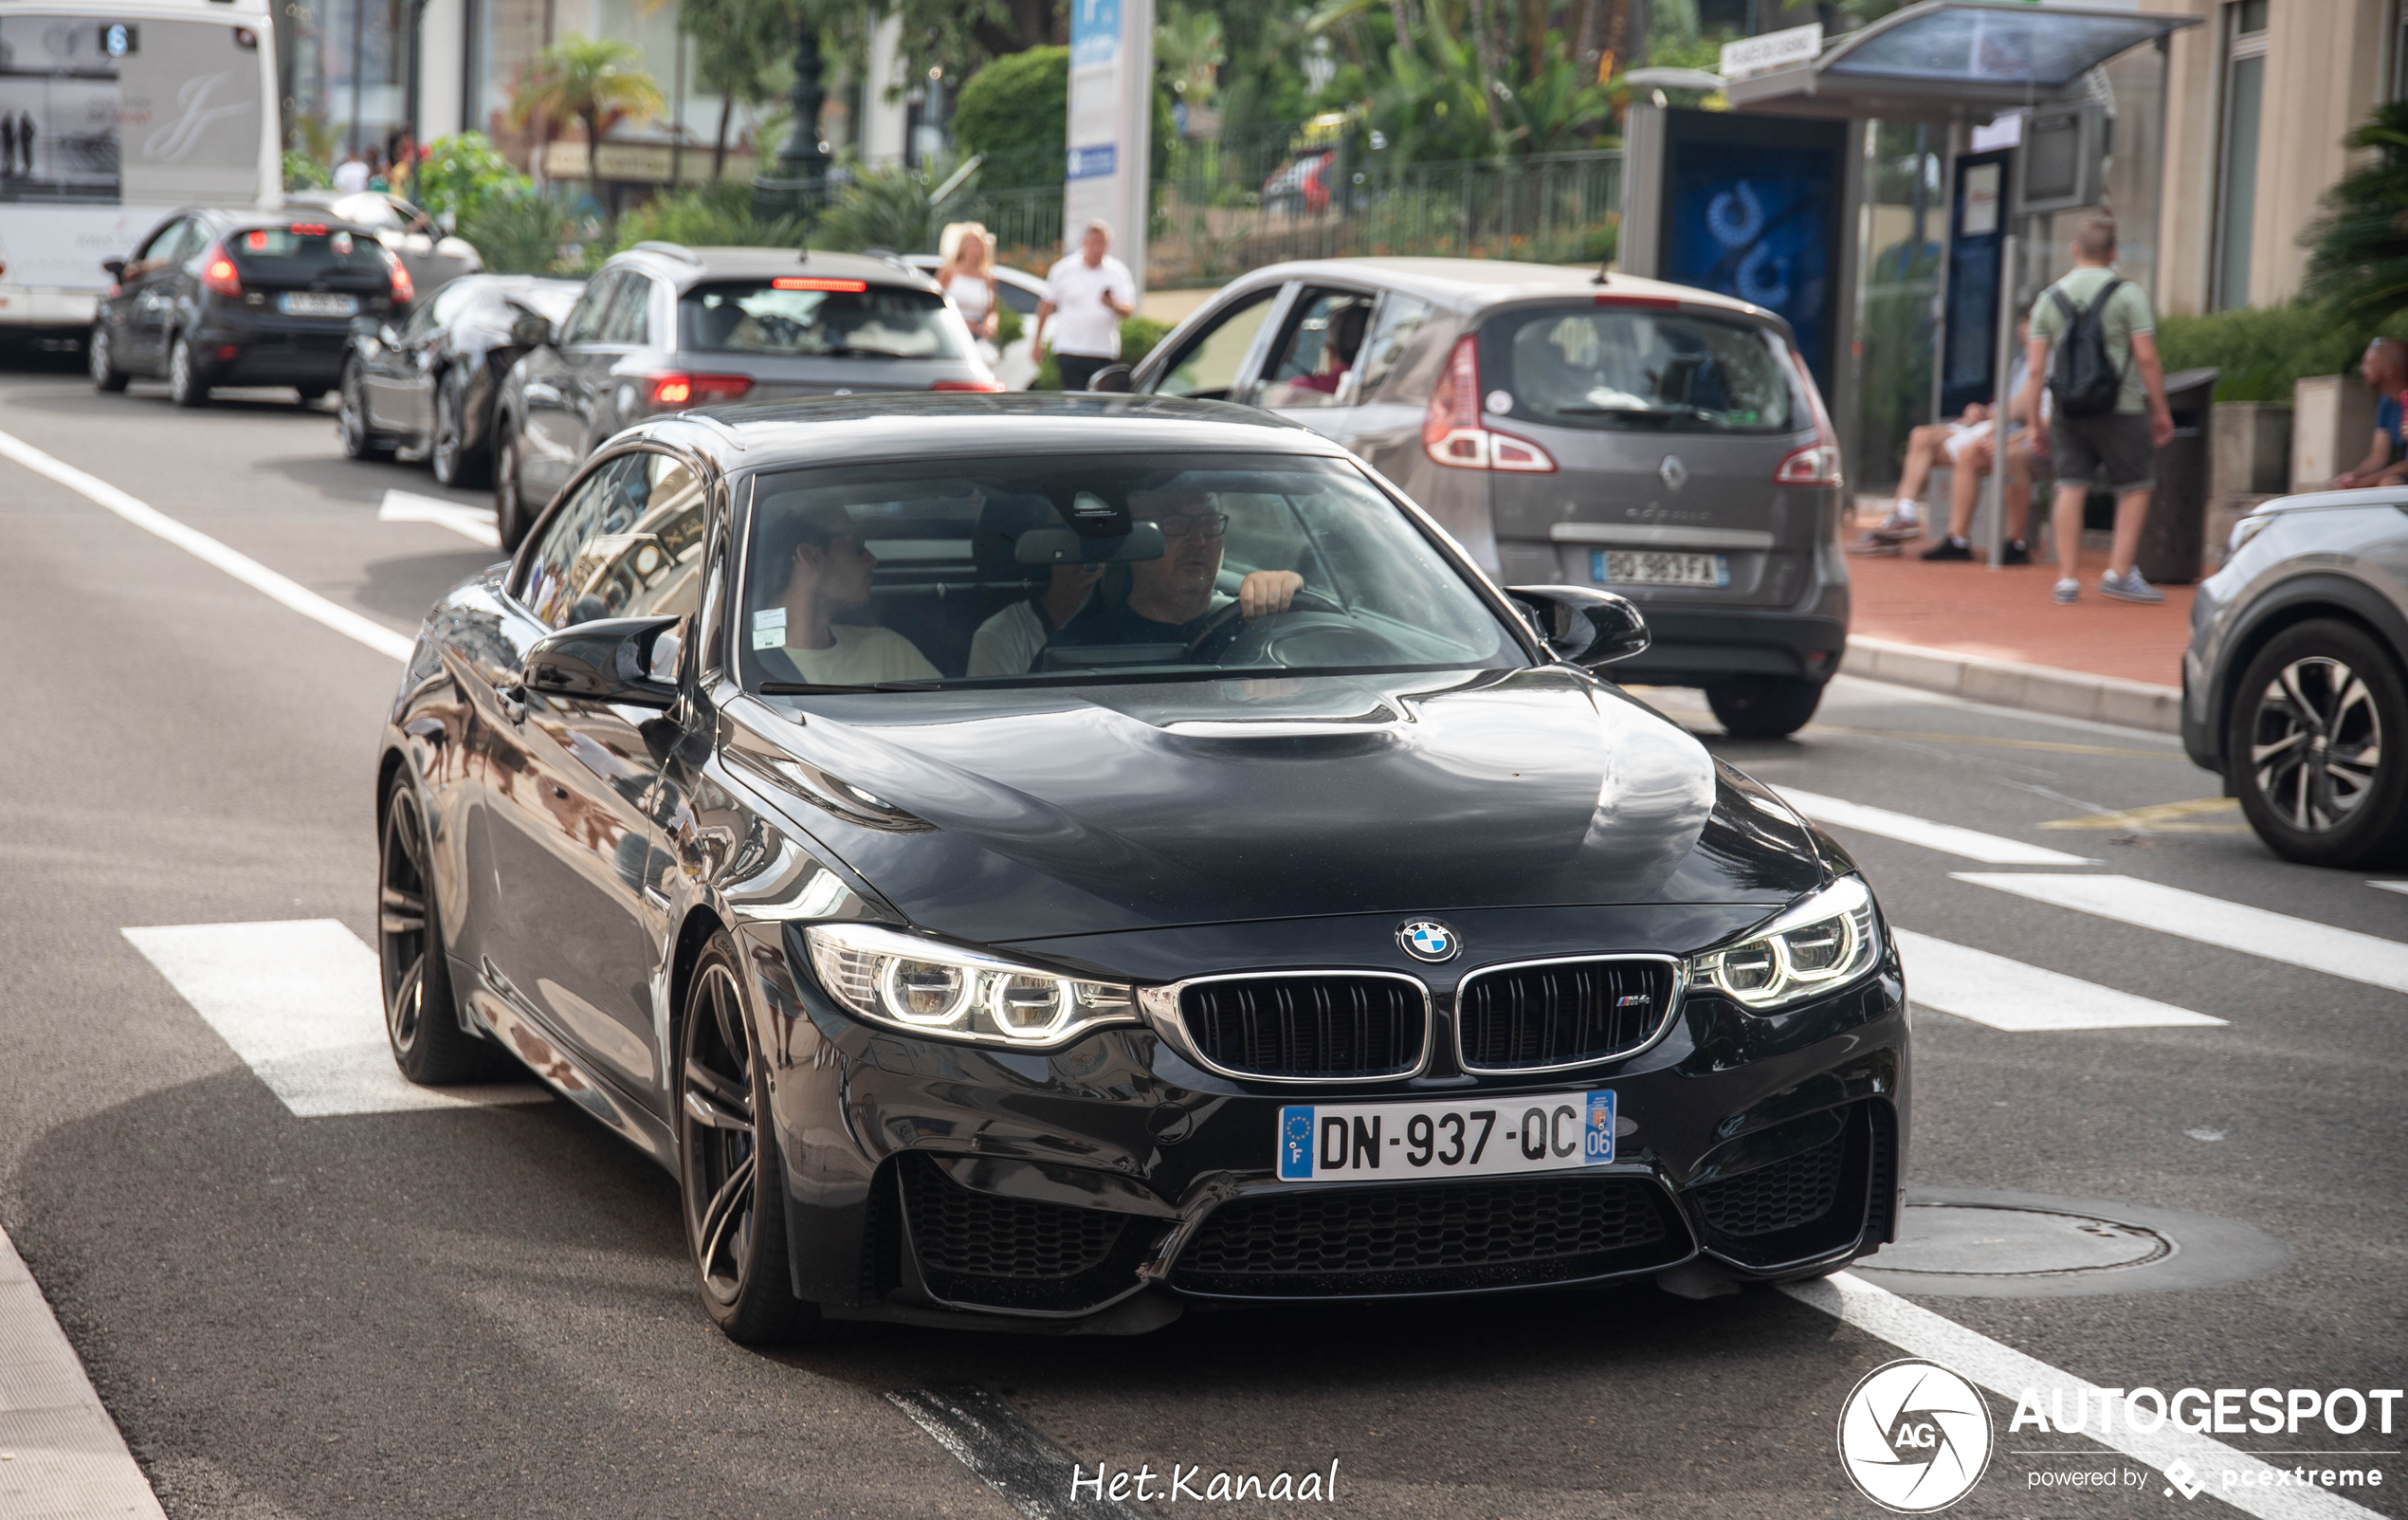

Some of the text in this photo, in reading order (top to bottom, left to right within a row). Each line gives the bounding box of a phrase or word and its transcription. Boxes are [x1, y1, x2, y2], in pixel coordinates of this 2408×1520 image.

[1404, 923, 1450, 937] BMW
[1625, 995, 1650, 1006] M4
[1320, 1105, 1577, 1170] DN-937-QC
[1587, 1129, 1611, 1156] 06
[1292, 1148, 1303, 1164] F
